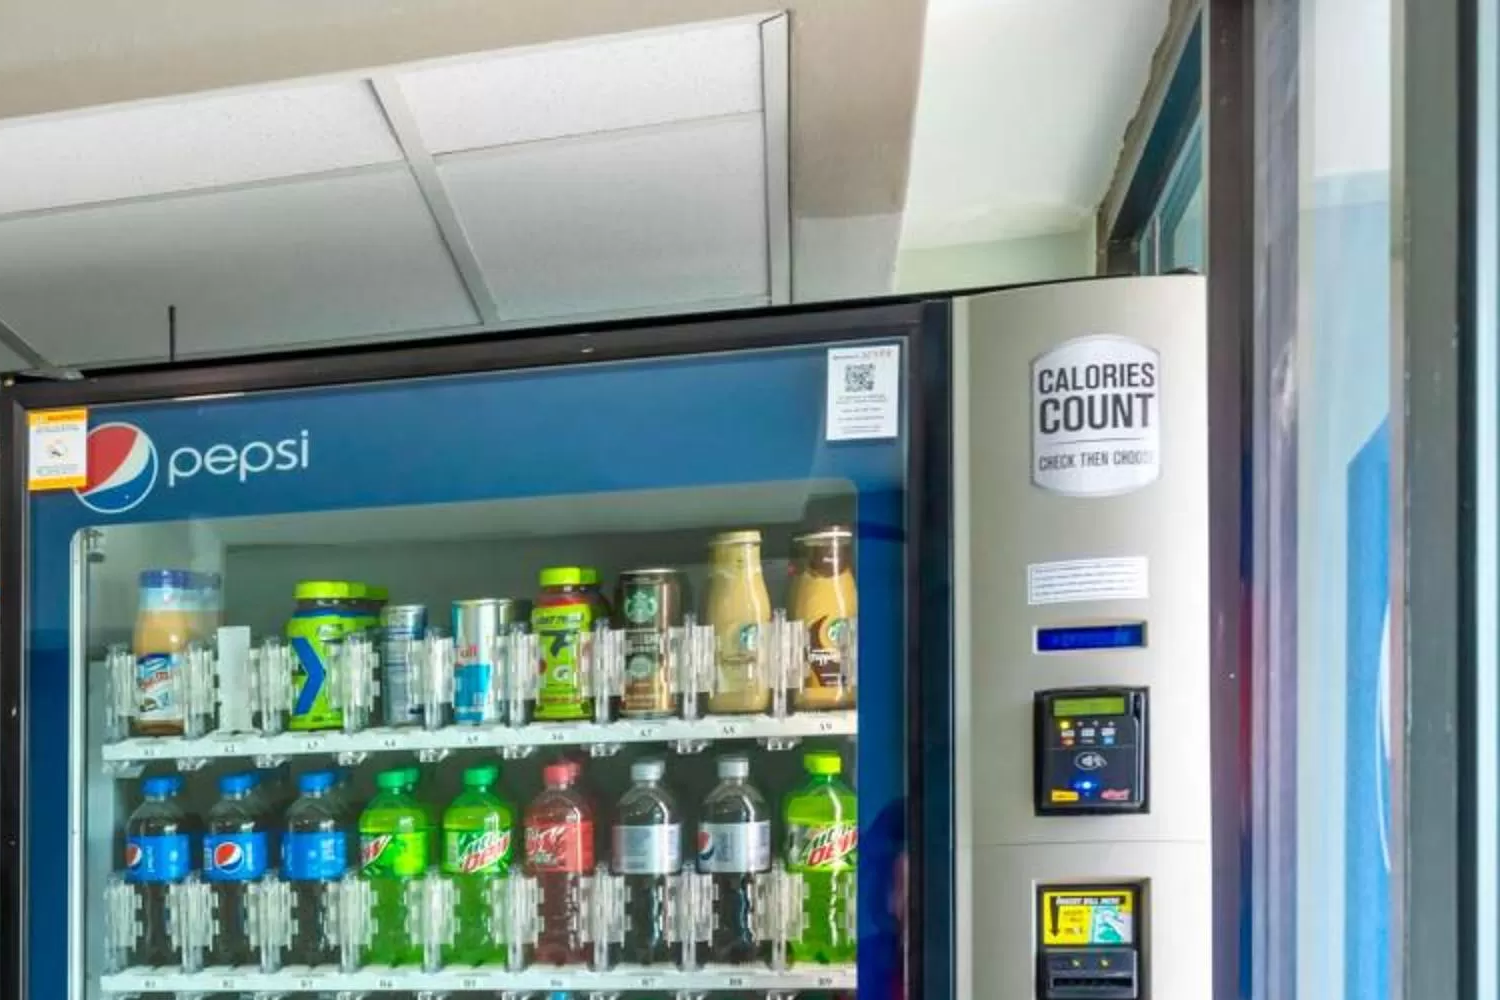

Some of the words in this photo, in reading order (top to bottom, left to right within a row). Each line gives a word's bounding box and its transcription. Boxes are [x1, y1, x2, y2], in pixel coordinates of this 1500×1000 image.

[1038, 362, 1155, 395] CALORIES
[1039, 393, 1155, 434] COUNT
[168, 430, 310, 487] pepsi
[1039, 453, 1076, 471] CHECK
[1080, 451, 1109, 468] THEN
